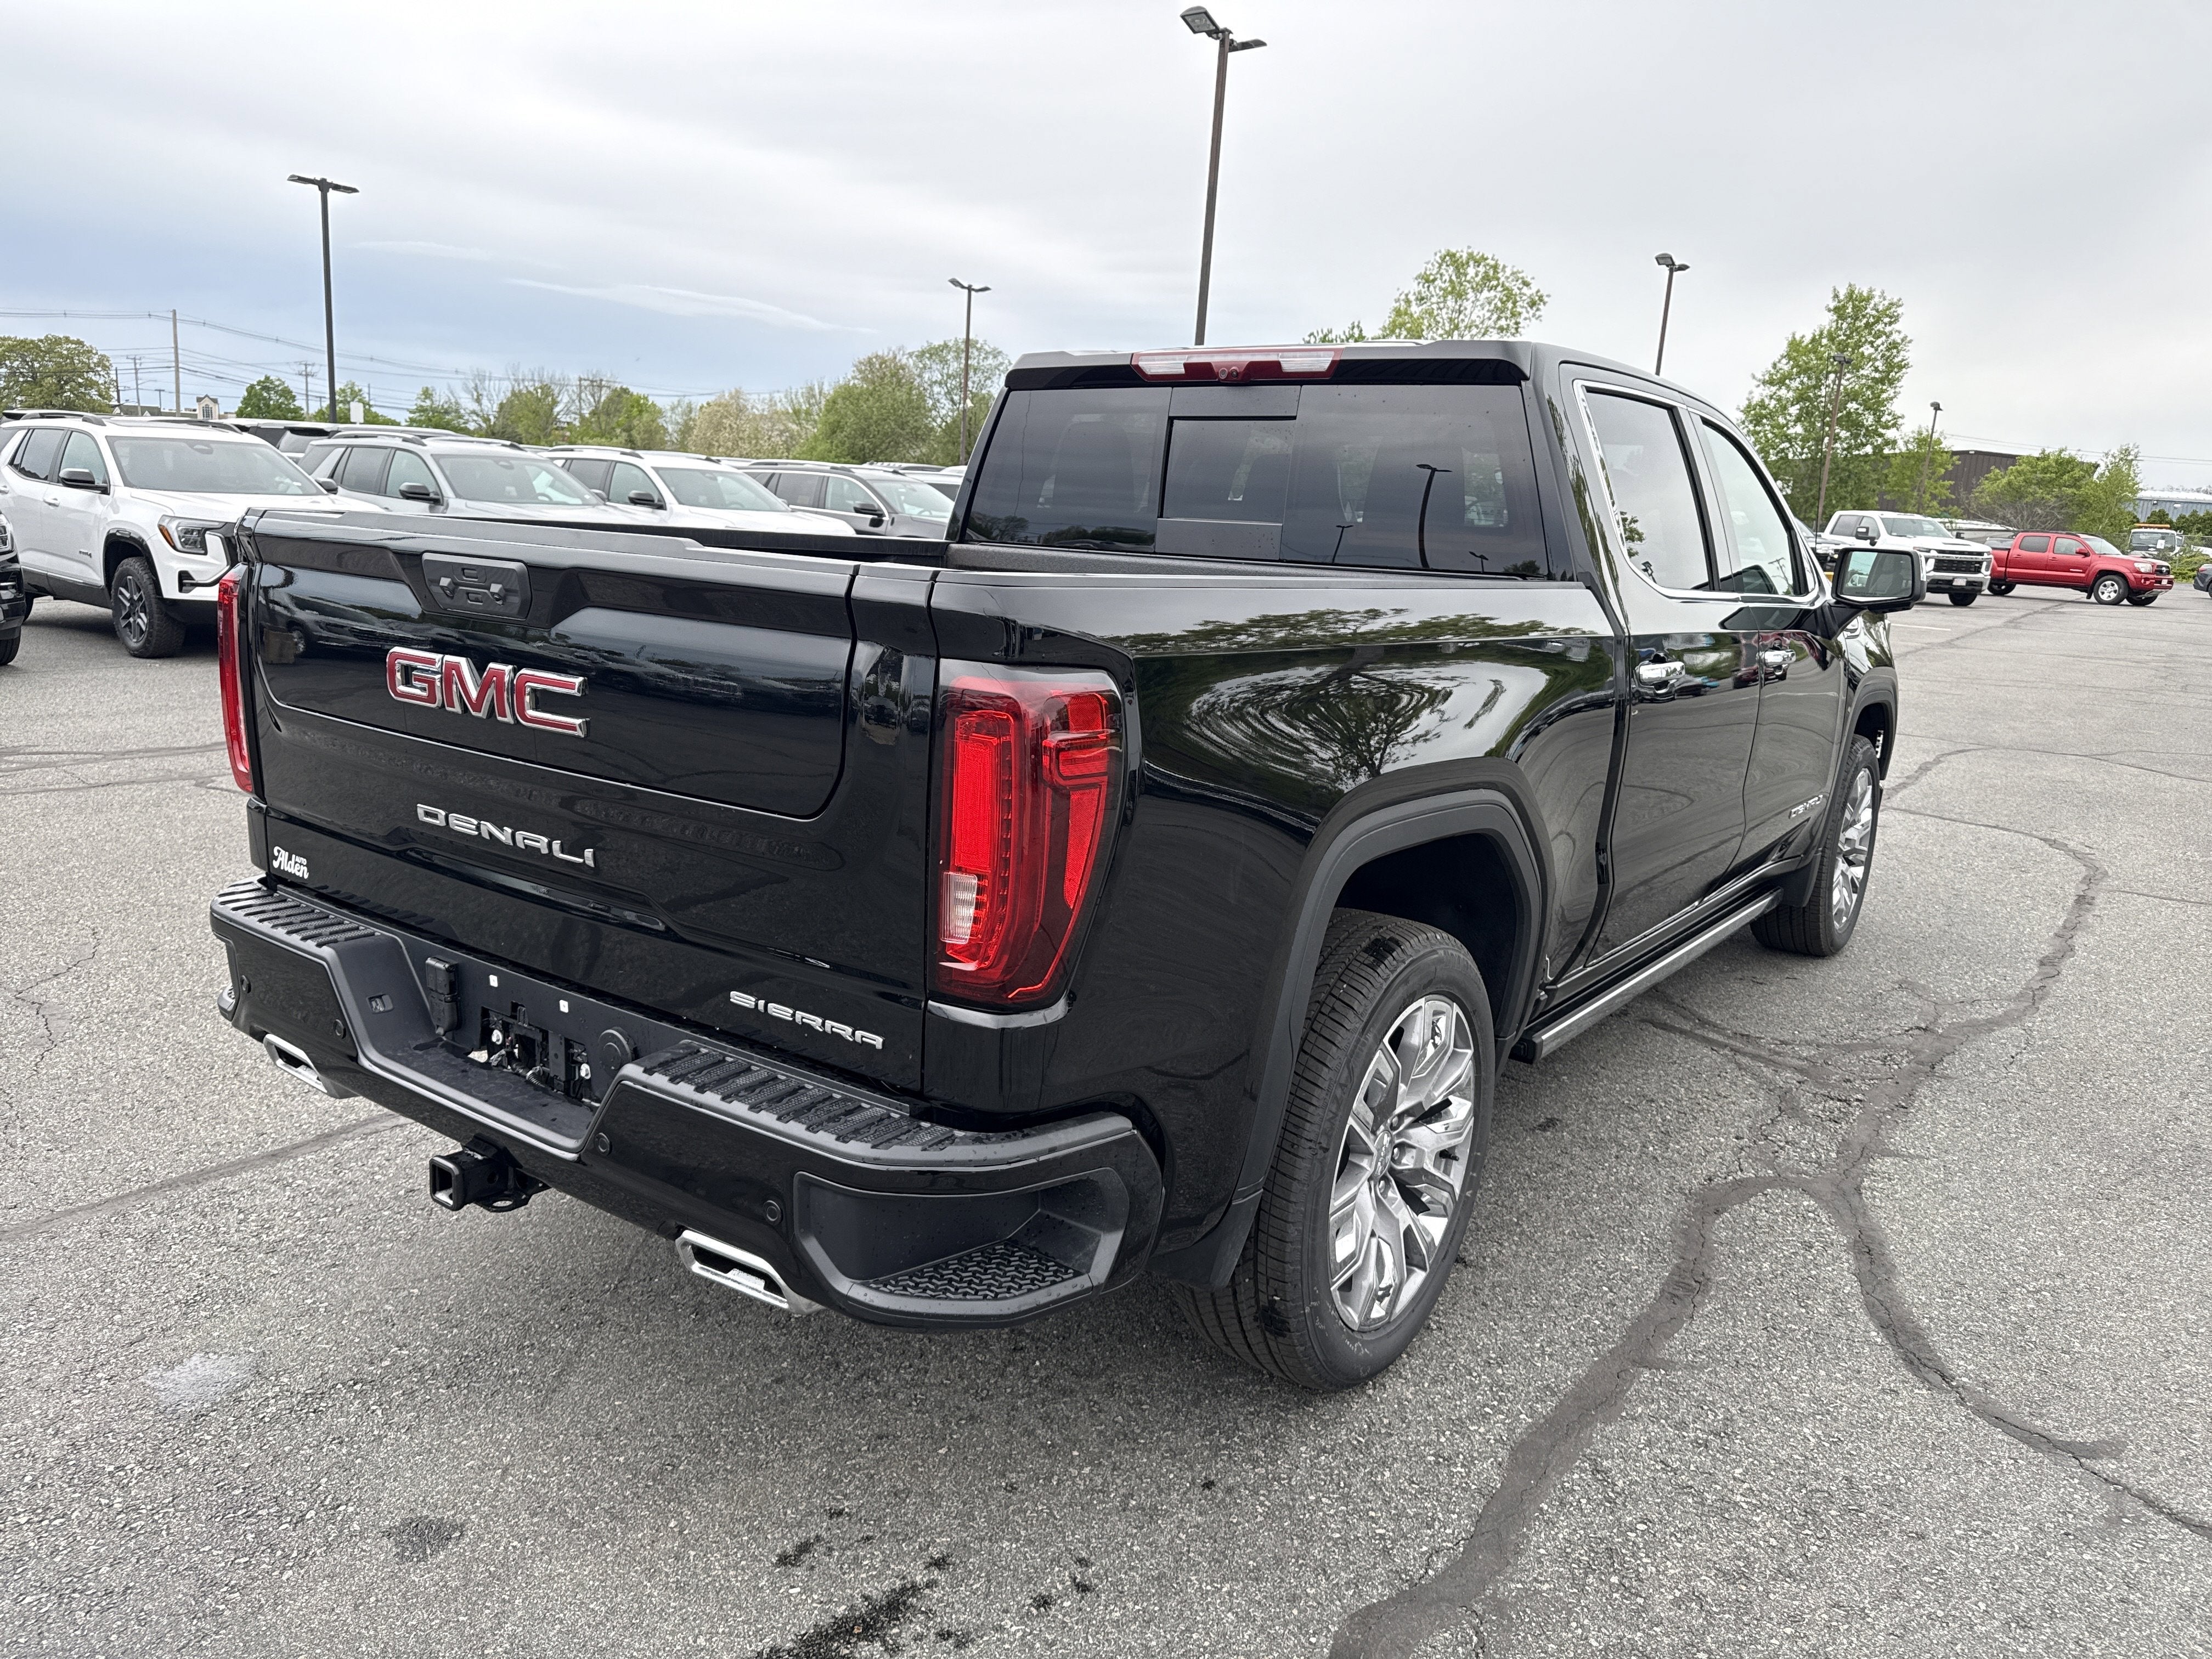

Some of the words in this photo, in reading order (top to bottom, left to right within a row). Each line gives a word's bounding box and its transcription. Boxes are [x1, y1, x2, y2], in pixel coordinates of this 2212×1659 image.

[386, 646, 589, 738] GMC
[273, 846, 309, 879] Alden
[417, 804, 595, 867] DENALI
[730, 991, 884, 1049] SIERRA
